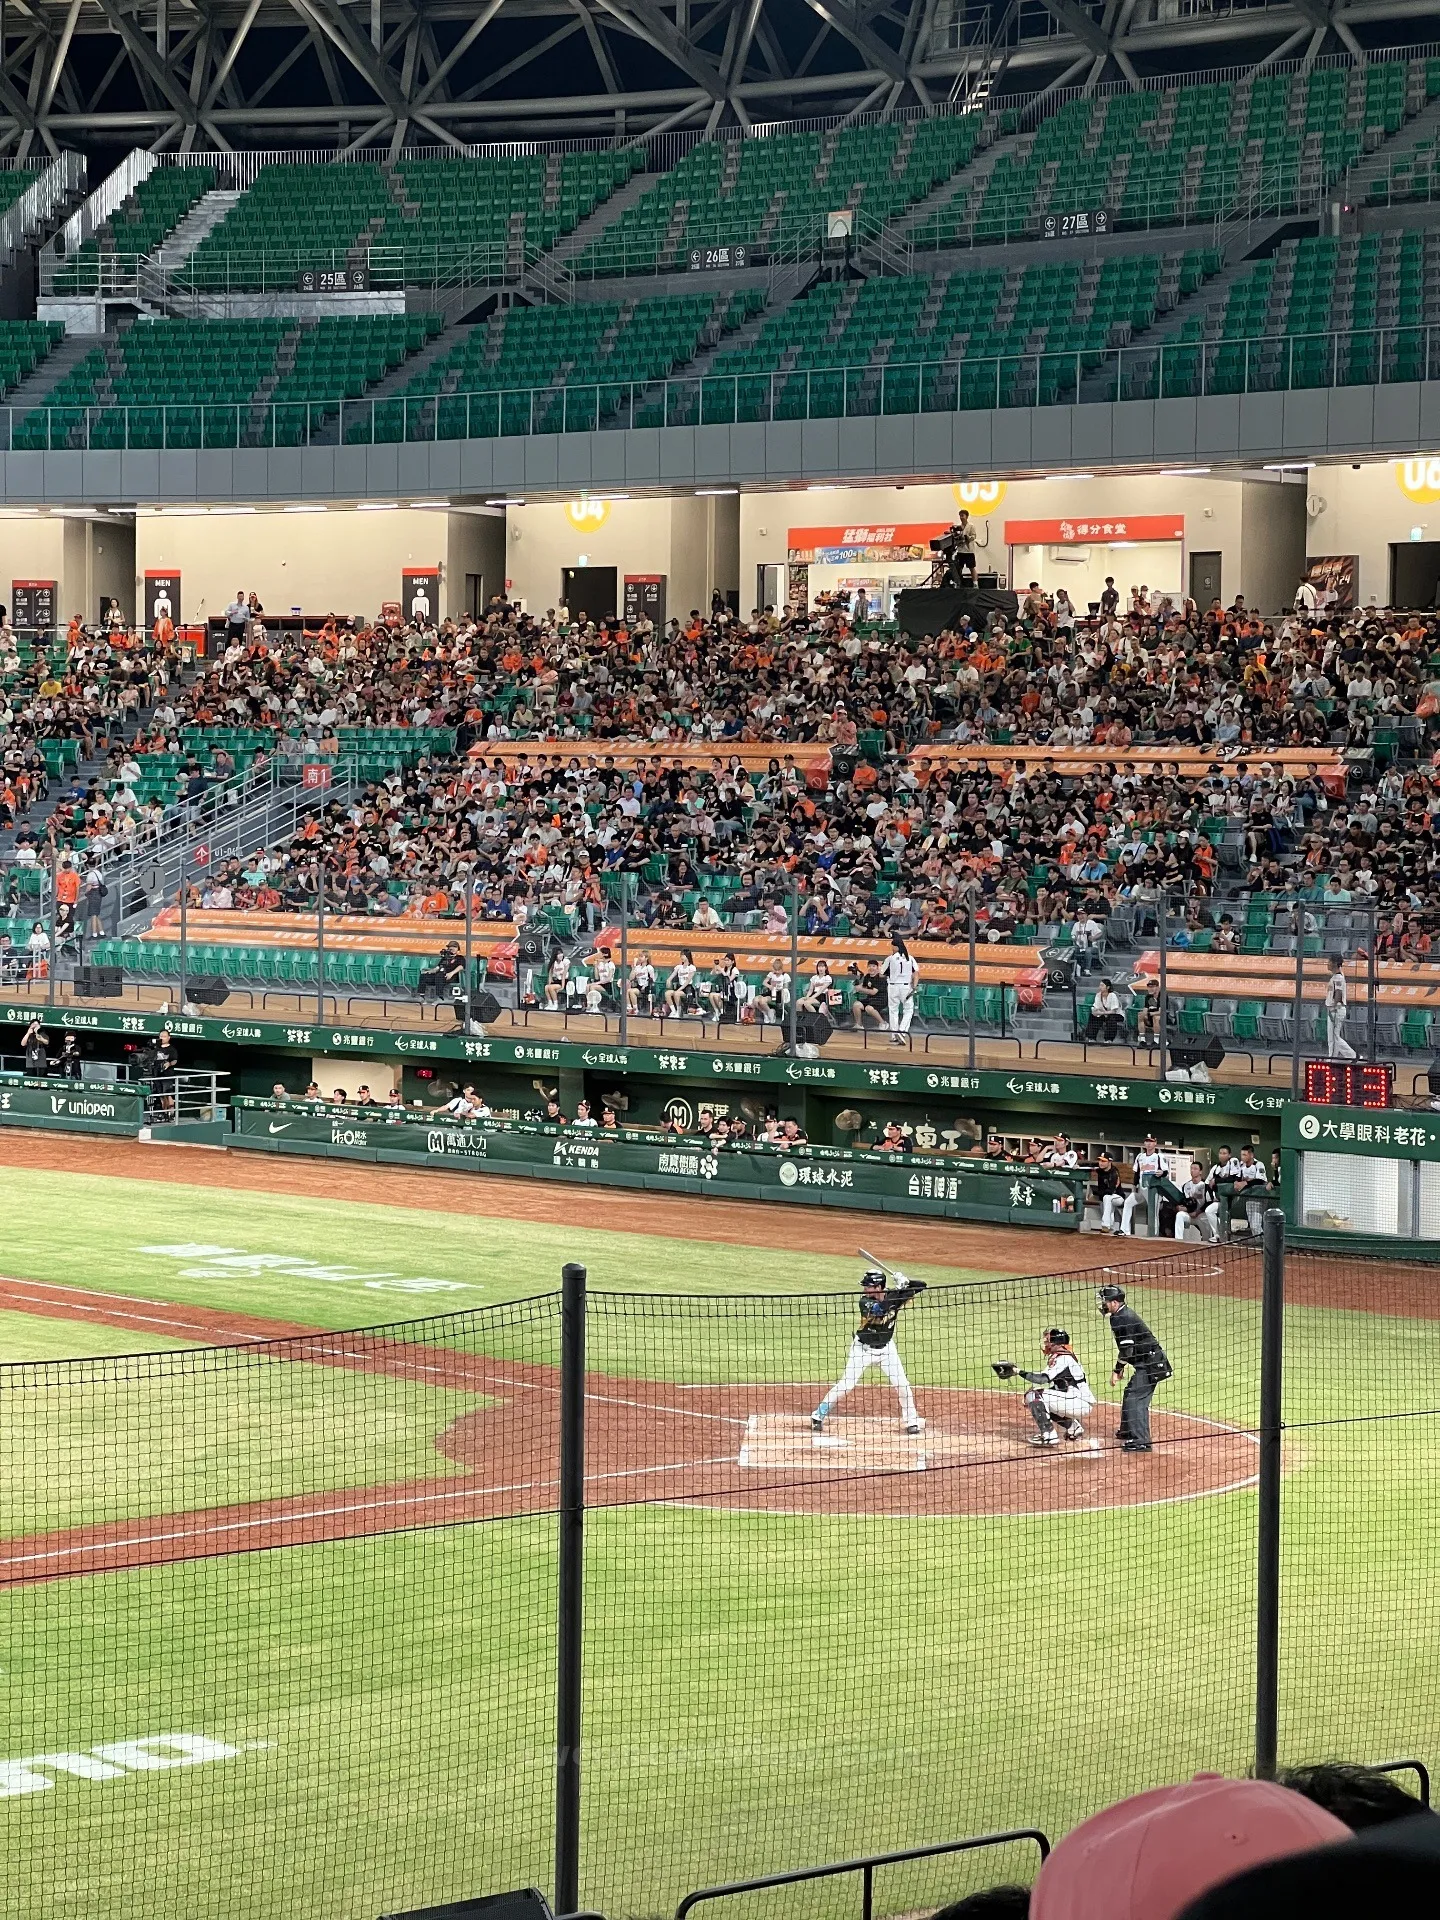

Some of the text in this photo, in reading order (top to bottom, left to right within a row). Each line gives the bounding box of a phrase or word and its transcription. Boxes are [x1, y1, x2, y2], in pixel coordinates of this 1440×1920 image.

[1062, 213, 1089, 230] 27區
[706, 248, 729, 263] 26區
[320, 272, 347, 286] 25區
[1076, 522, 1127, 535] 得分食堂
[155, 579, 171, 587] MEN
[412, 577, 429, 585] MEN
[725, 1062, 762, 1074] 兆豐銀行
[940, 1076, 980, 1089] 兆豐銀行
[1173, 1091, 1216, 1105] 兆豐銀行
[69, 1099, 115, 1116] uniopen
[446, 1132, 487, 1150] 萬通人力
[568, 1145, 599, 1157] KENDA
[658, 1152, 699, 1169] 南寶樹脂
[798, 1166, 854, 1188] 環球水泥
